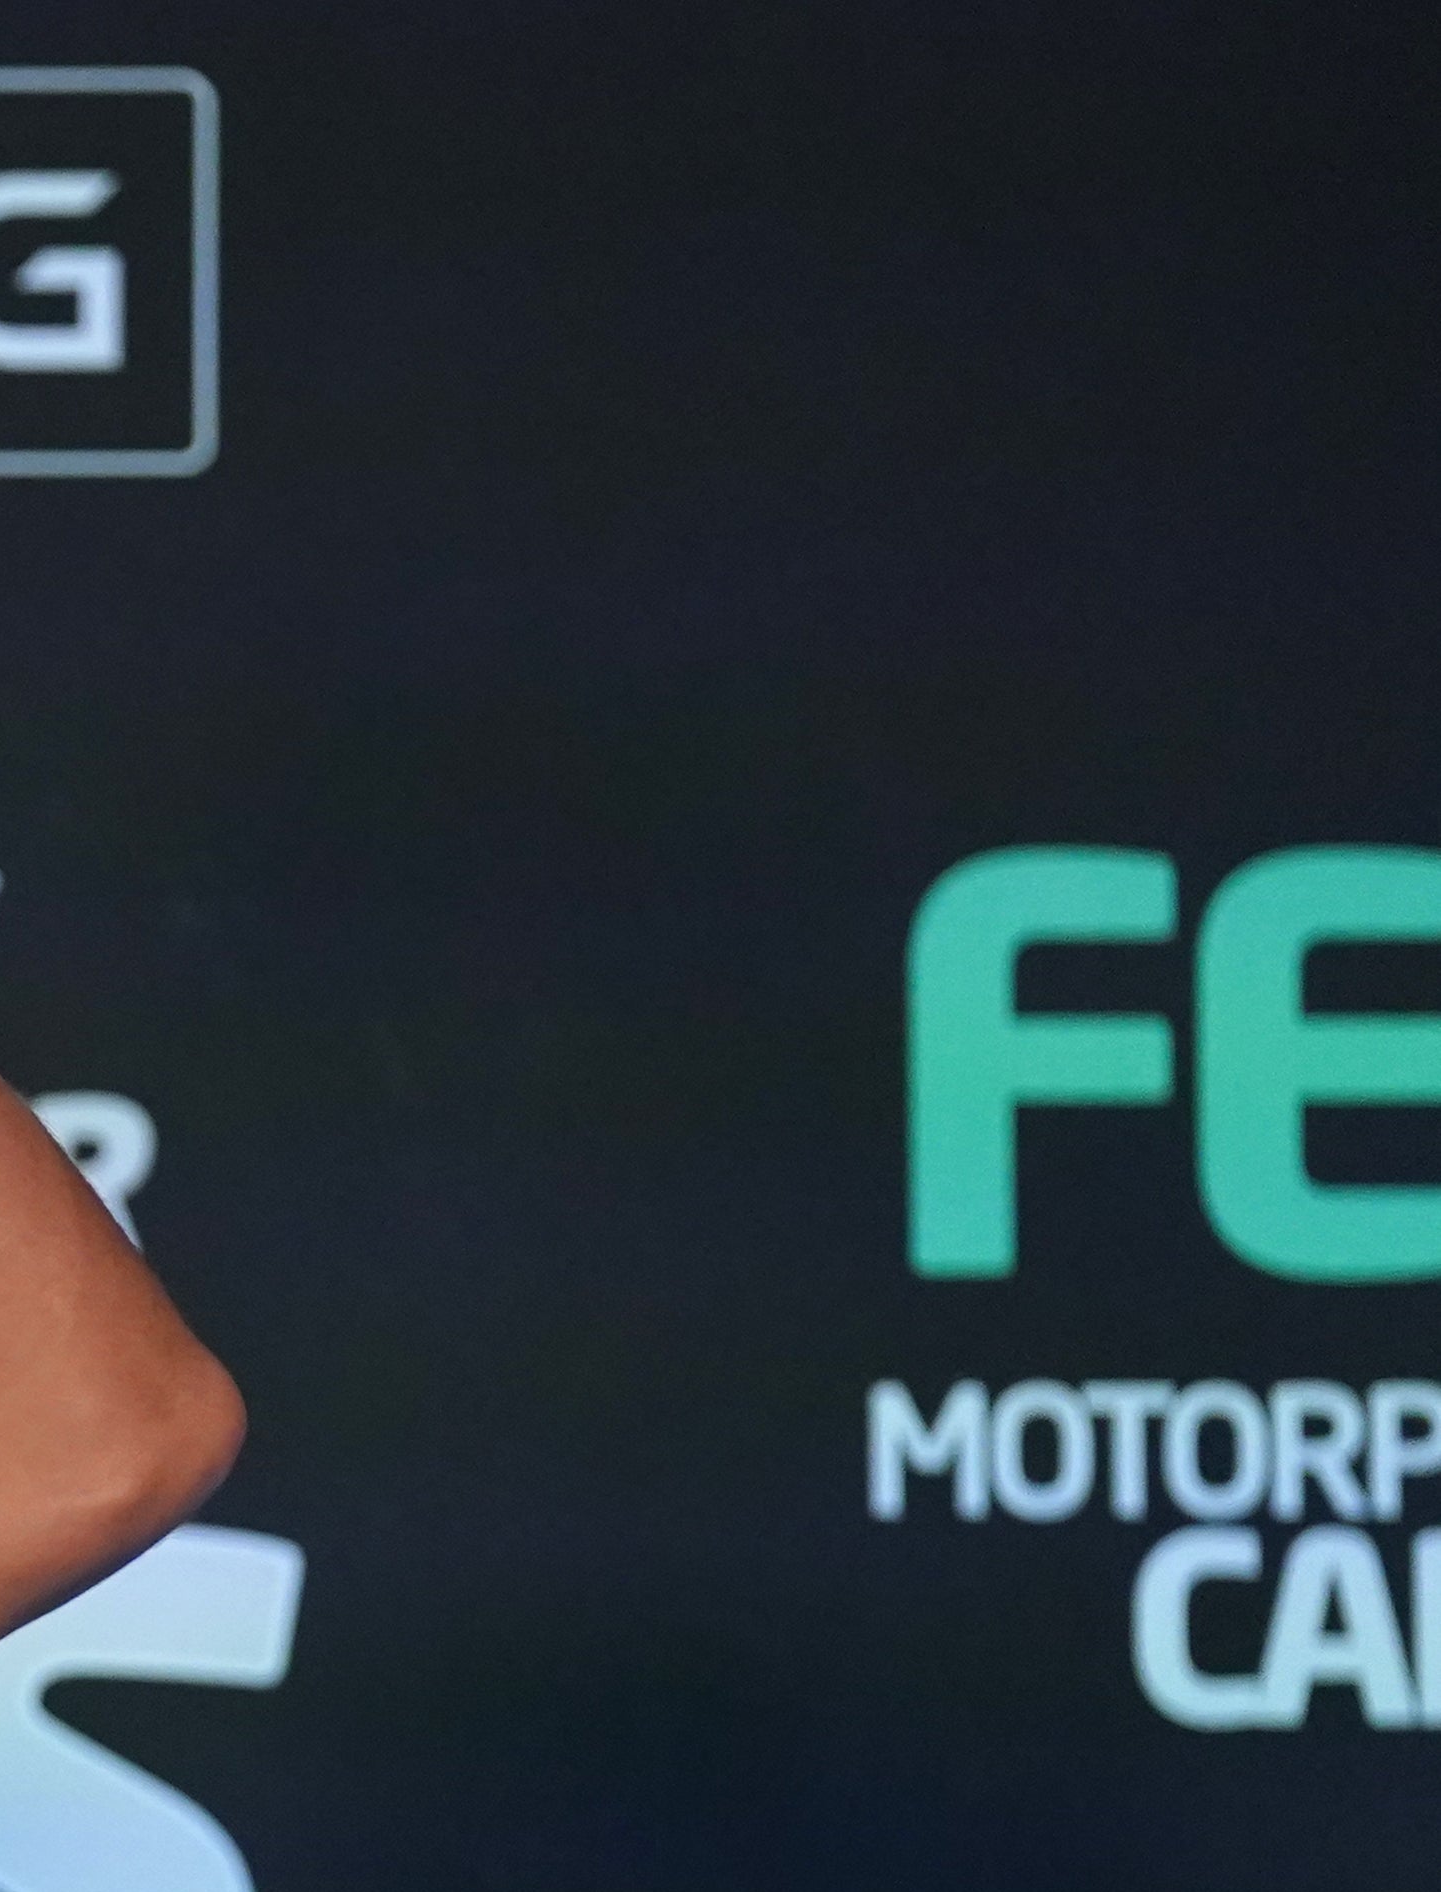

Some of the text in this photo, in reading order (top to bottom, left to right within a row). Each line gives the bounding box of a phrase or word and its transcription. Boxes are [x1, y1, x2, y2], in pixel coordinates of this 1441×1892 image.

[905, 845, 1441, 1284] FE
[866, 1378, 1441, 1522] MOTORP
[1129, 1524, 1441, 1730] CA
